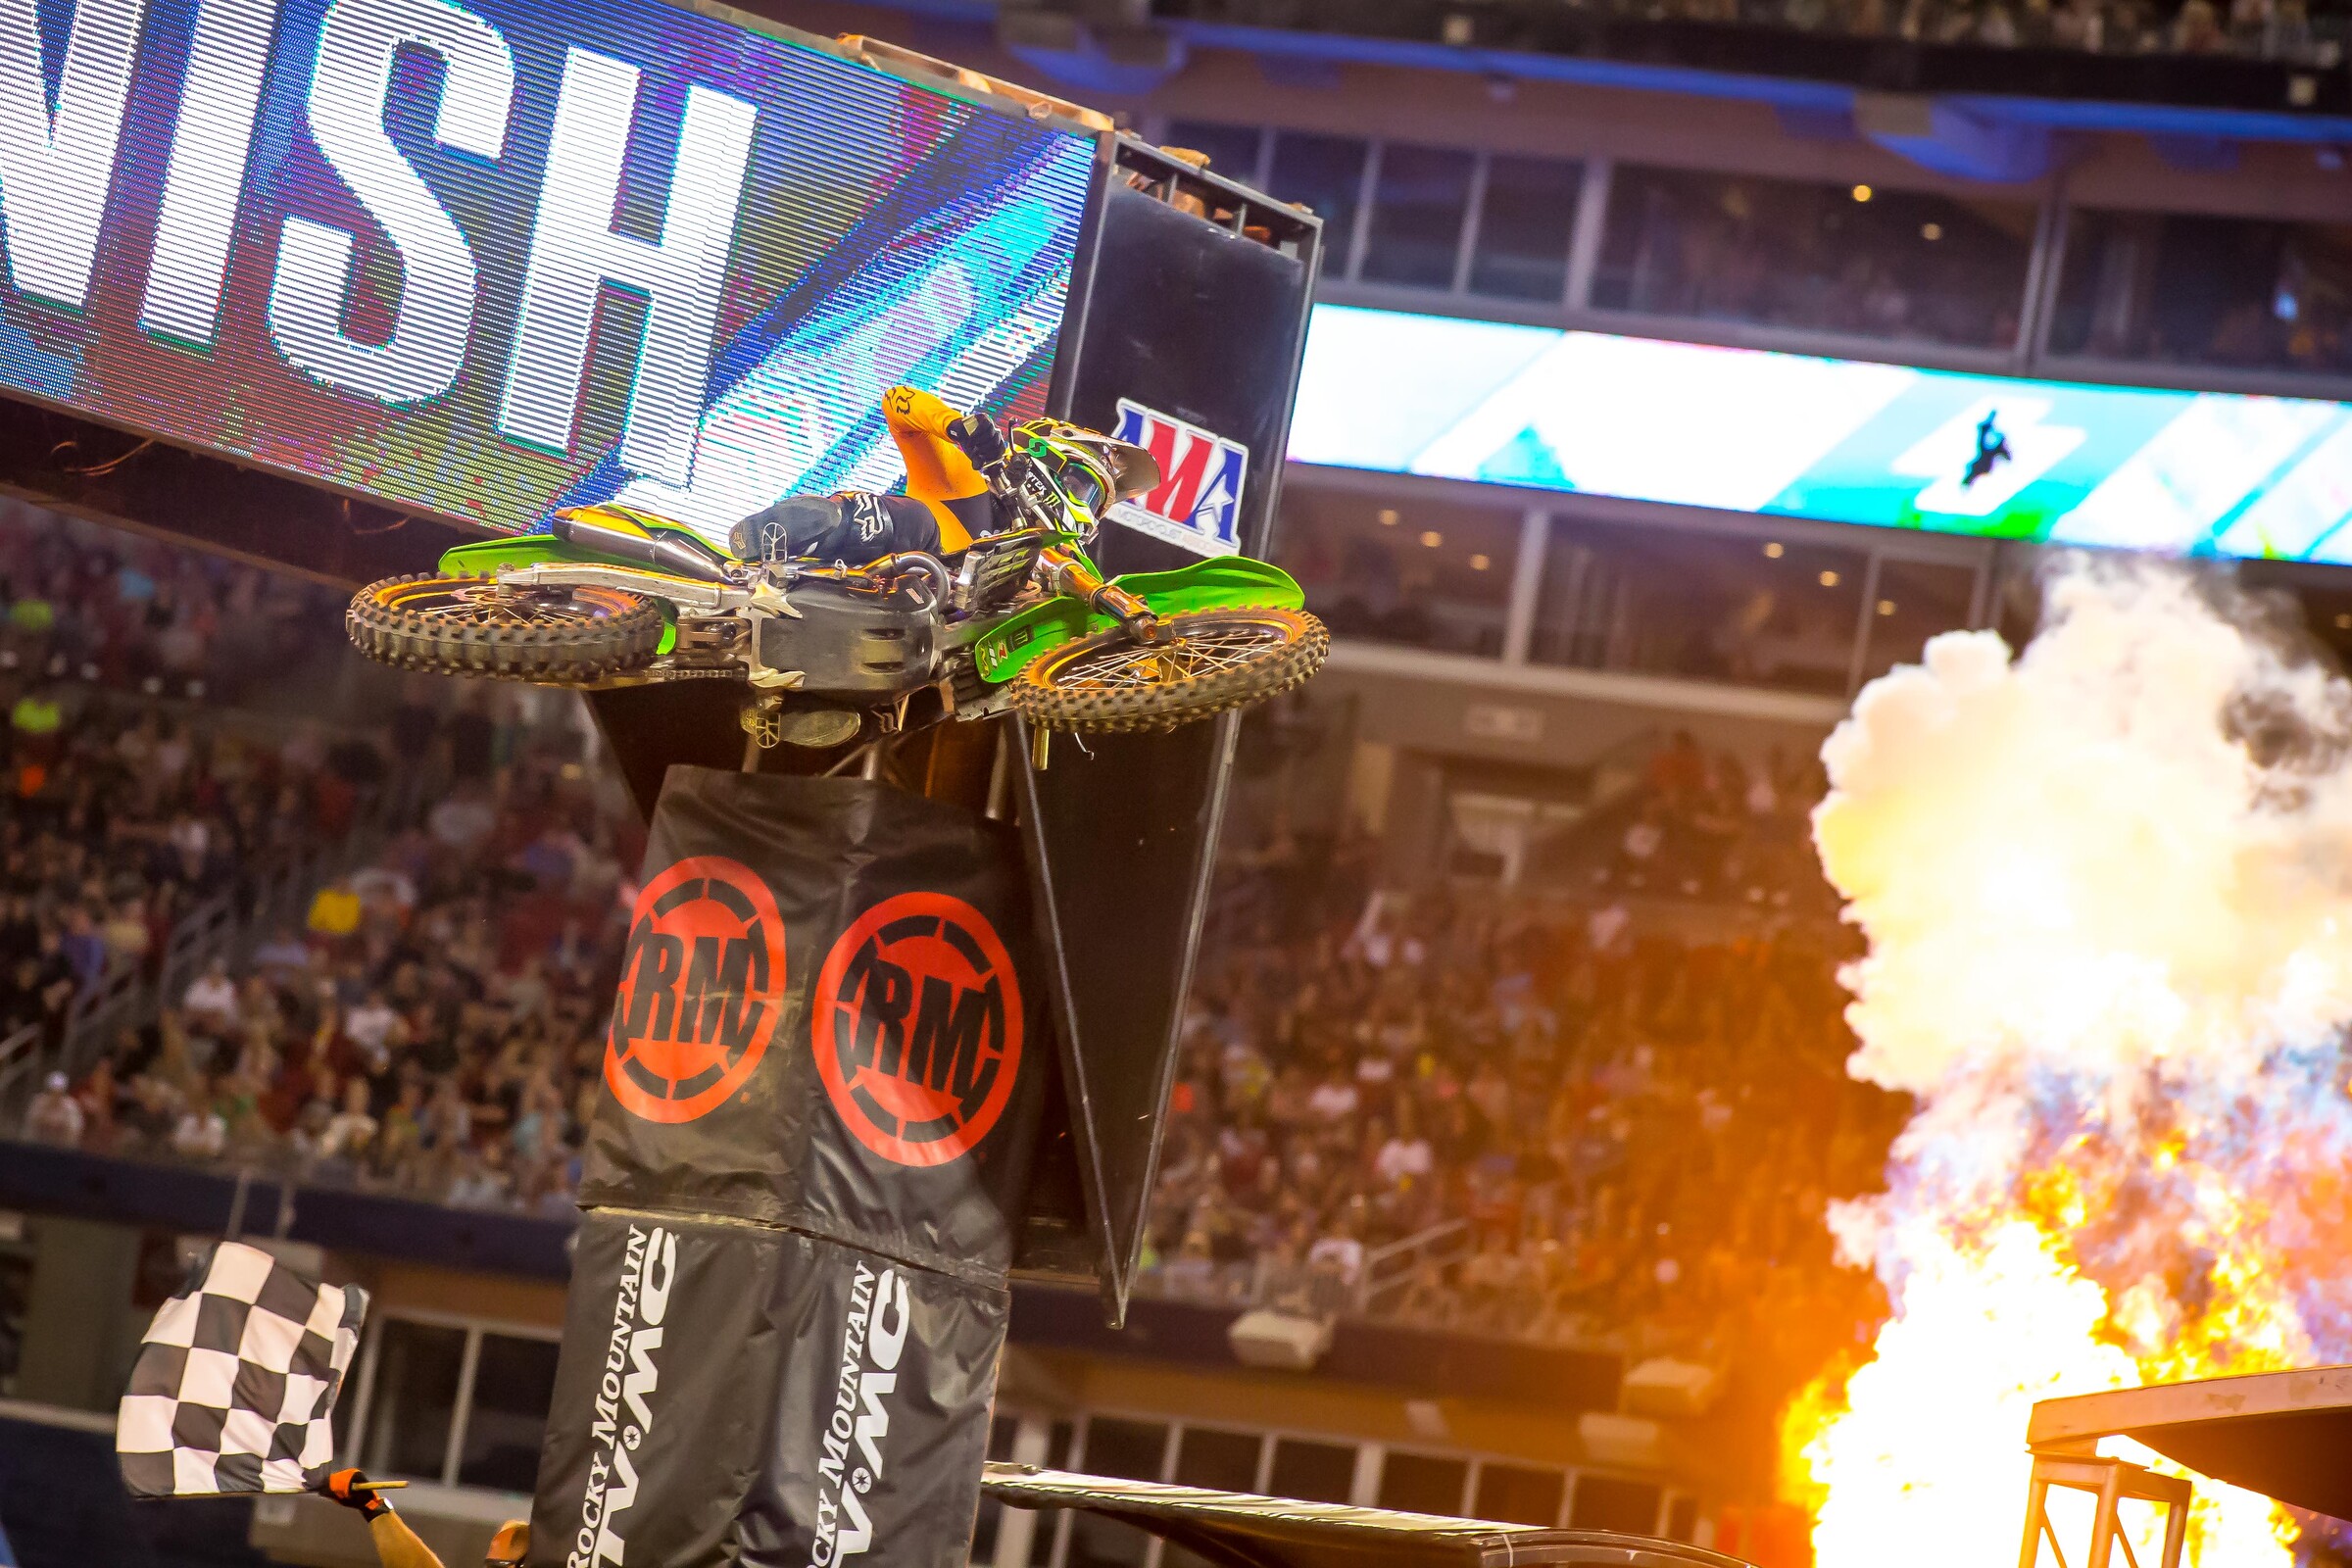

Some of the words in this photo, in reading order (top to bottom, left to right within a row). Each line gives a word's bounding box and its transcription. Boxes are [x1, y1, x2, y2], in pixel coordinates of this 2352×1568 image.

[855, 956, 992, 1102] RM
[592, 1223, 648, 1450] MOUNTAIN
[818, 1259, 876, 1490] MOUNTAIN
[807, 1488, 839, 1568] CKY
